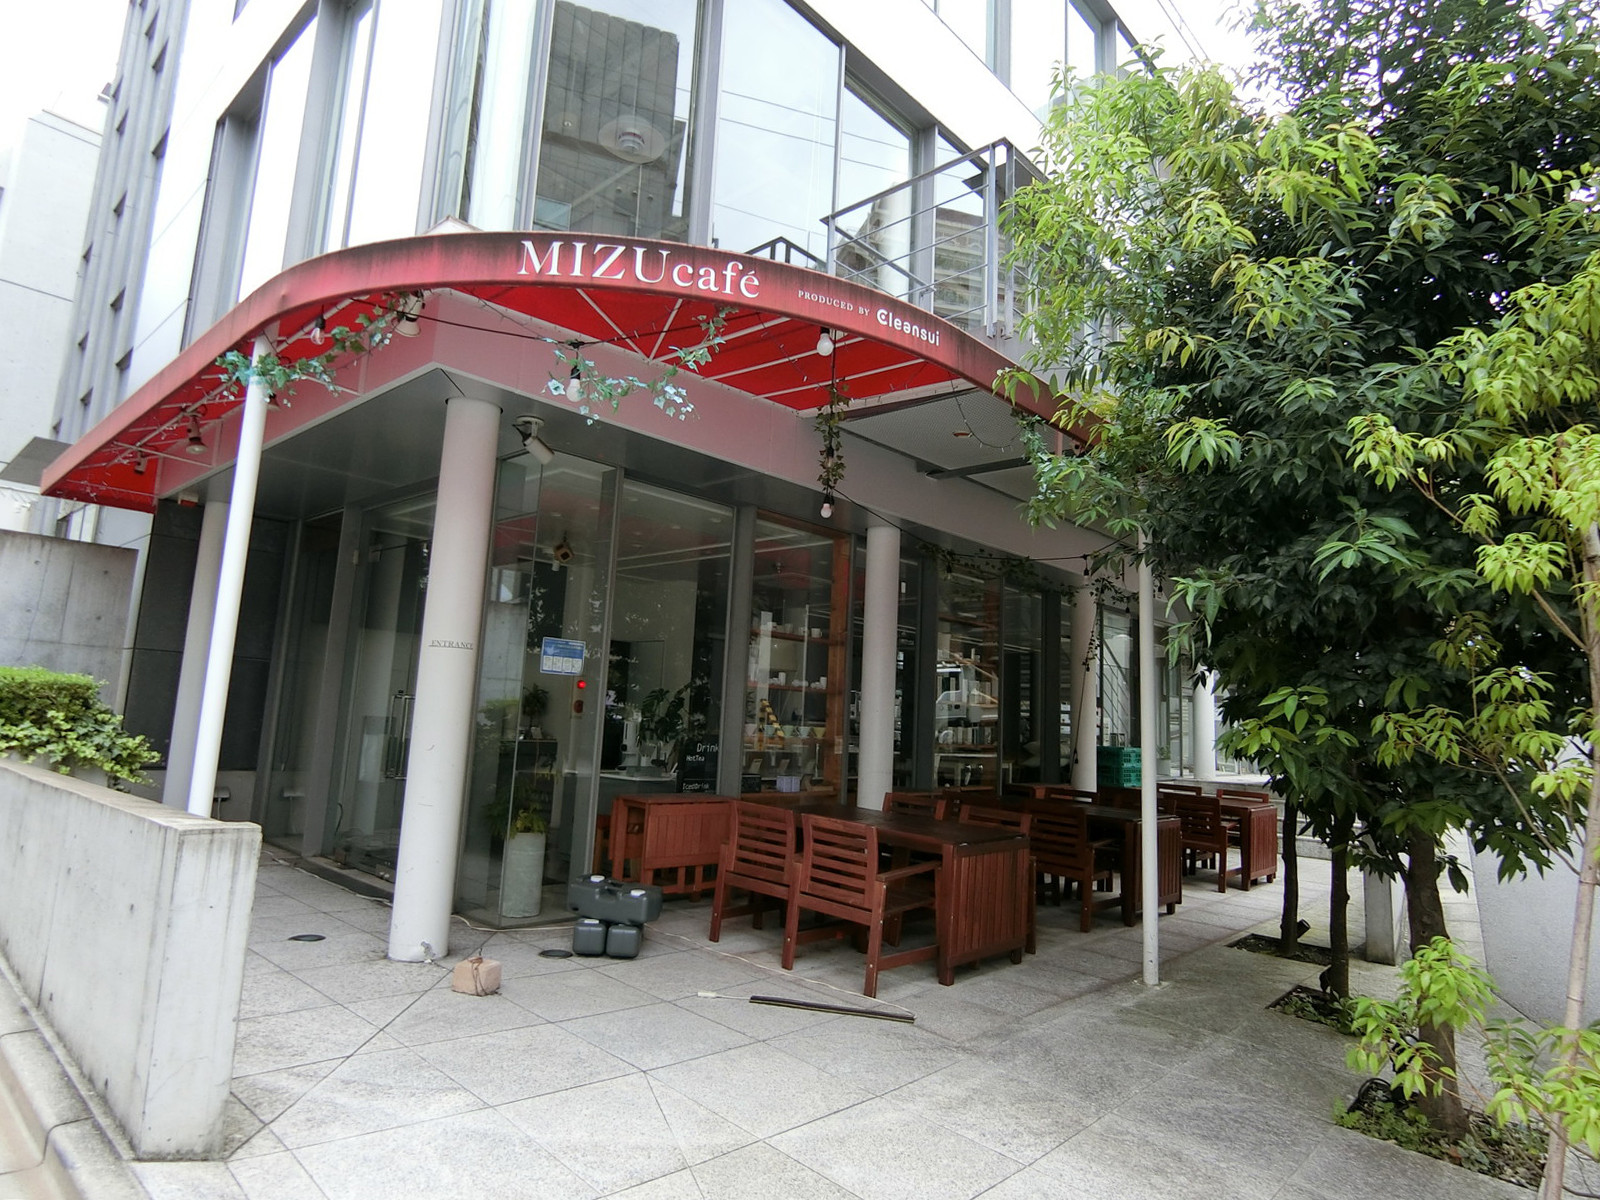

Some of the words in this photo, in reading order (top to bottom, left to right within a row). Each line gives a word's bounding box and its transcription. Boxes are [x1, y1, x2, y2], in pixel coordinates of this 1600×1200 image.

[798, 289, 854, 312] PRODUCED
[858, 306, 870, 316] BY
[876, 308, 941, 347] Cleansui
